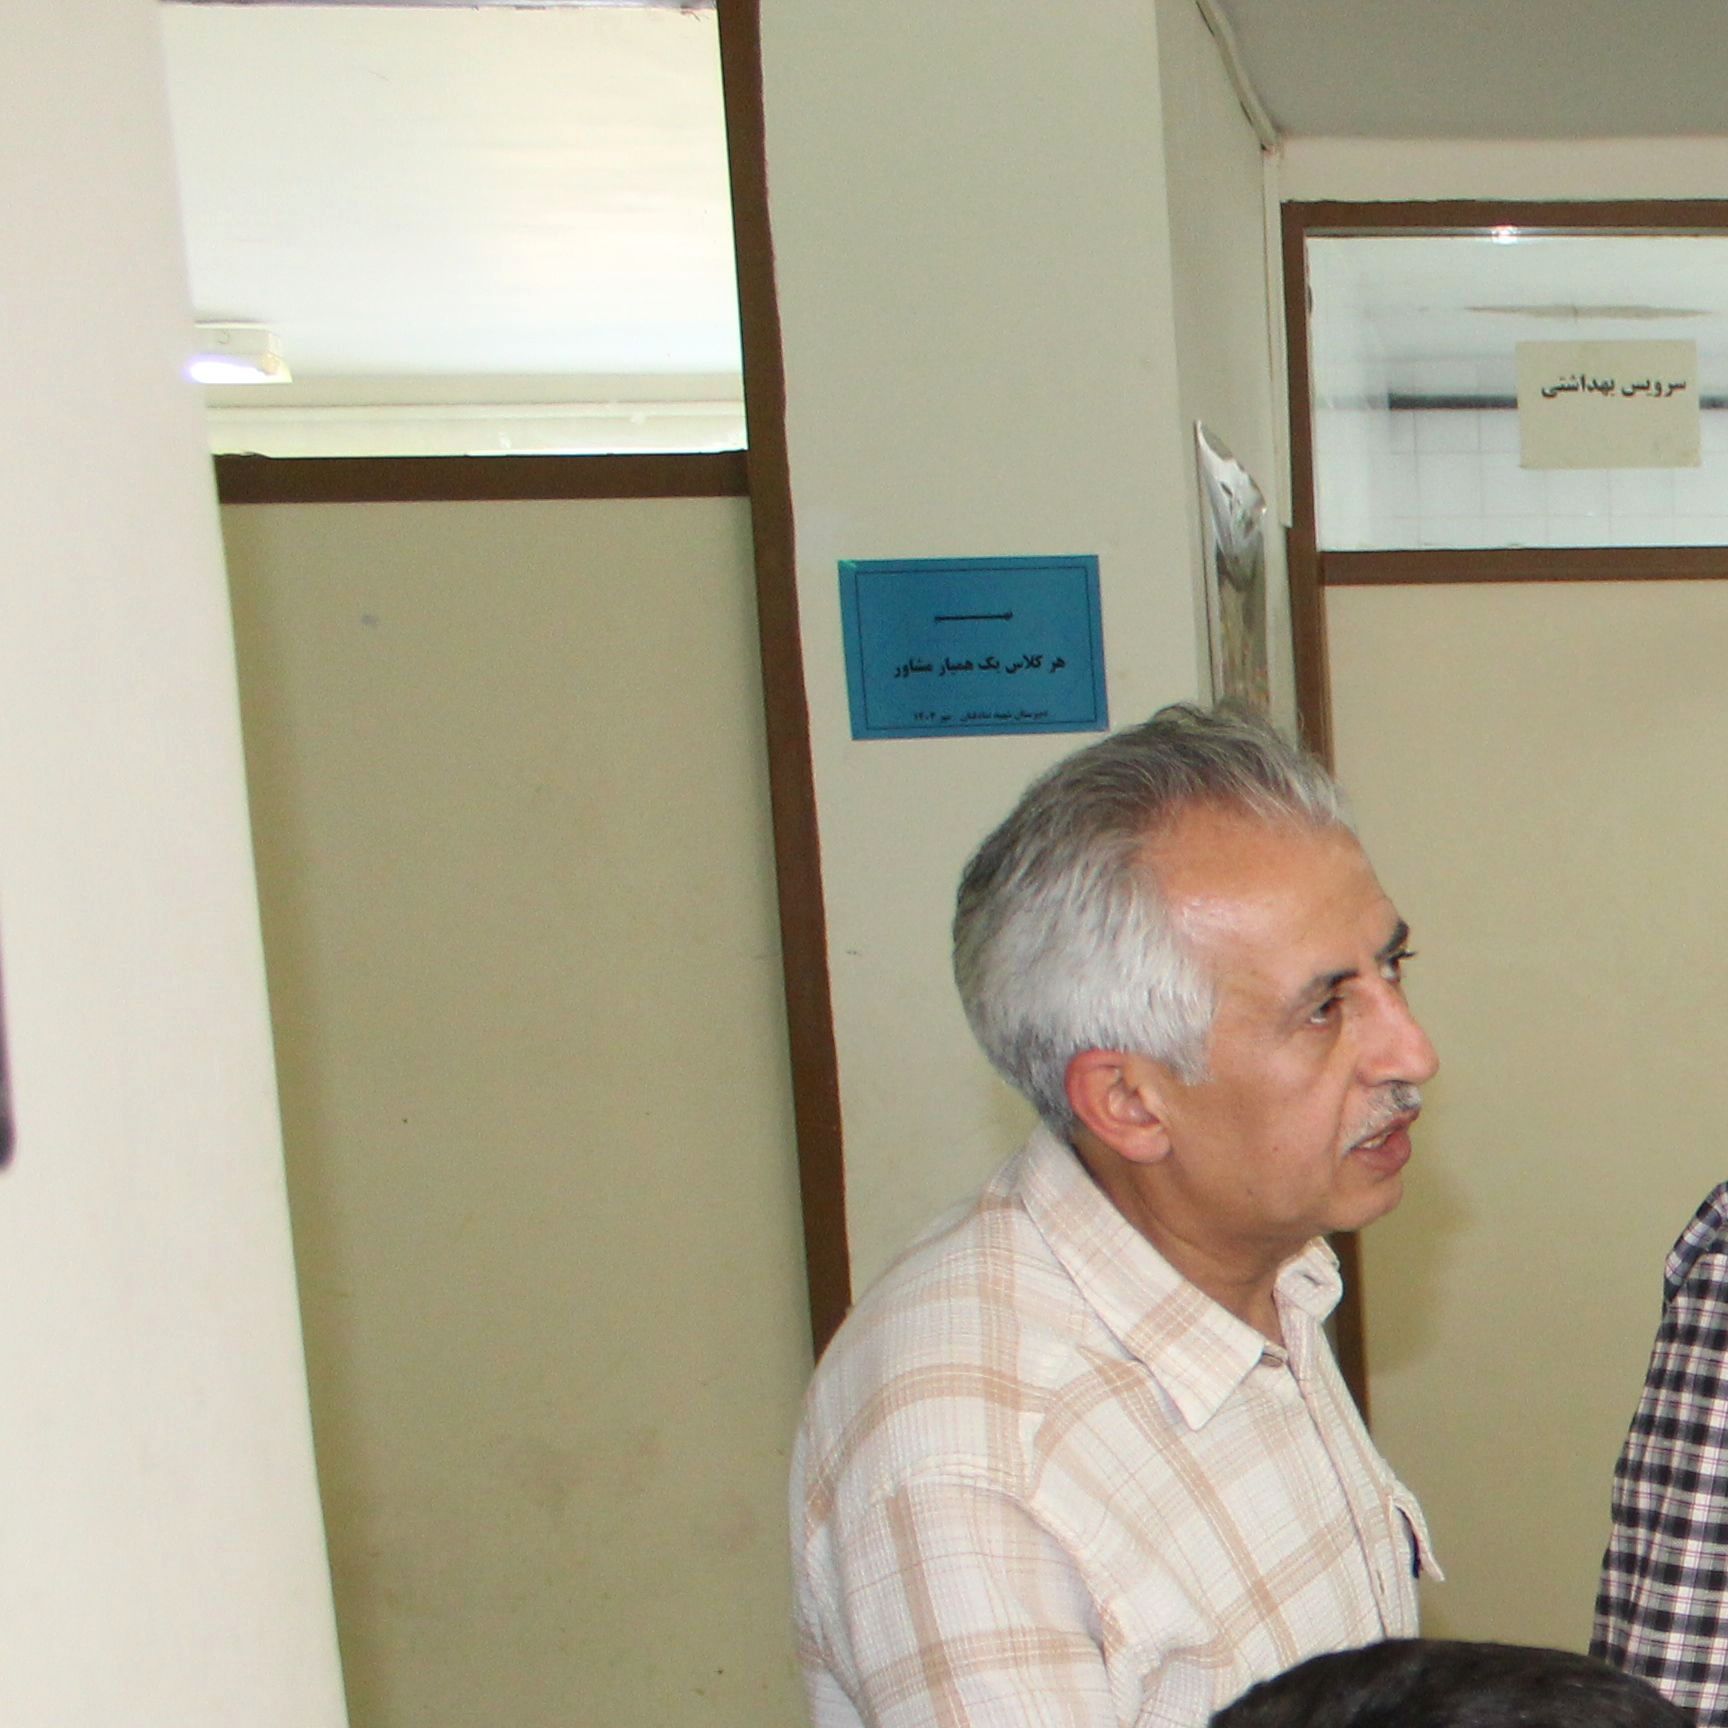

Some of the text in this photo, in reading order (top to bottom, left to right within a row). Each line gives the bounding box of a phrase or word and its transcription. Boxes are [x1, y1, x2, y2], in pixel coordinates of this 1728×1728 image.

[1541, 373, 1688, 398] سرویس بهداشتی
[893, 653, 1067, 679] هر کلاس یک همیار مشاور
